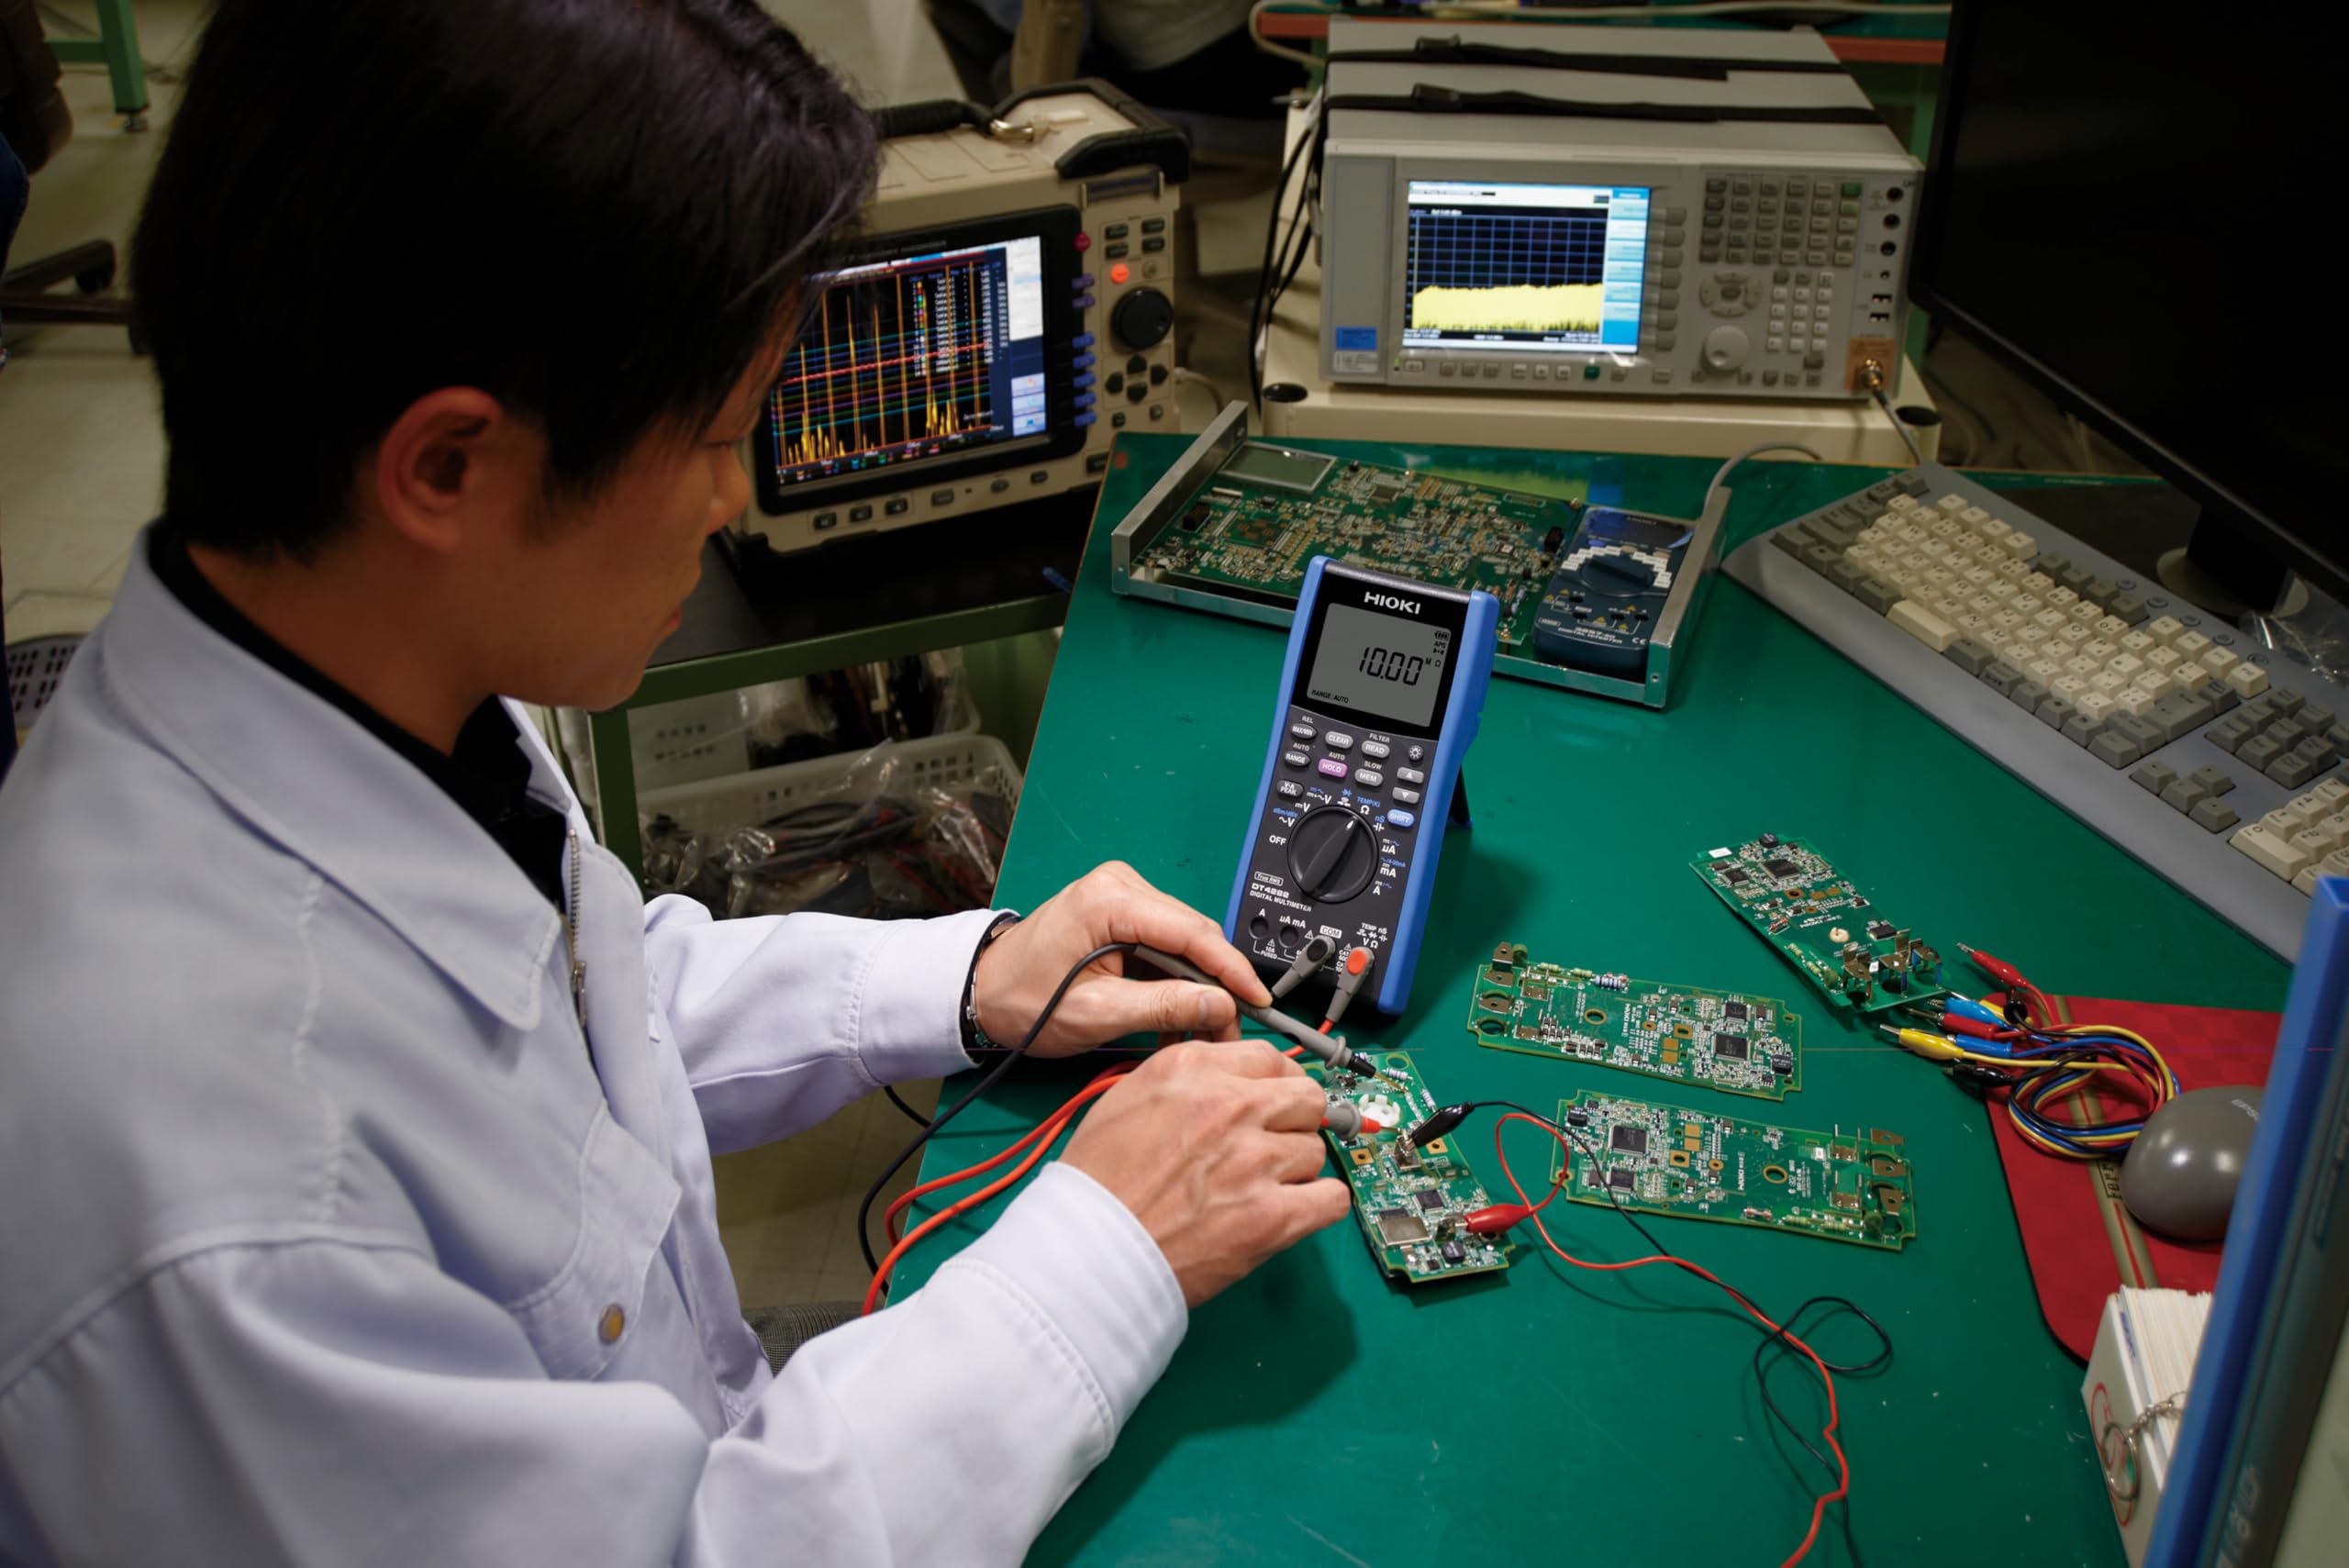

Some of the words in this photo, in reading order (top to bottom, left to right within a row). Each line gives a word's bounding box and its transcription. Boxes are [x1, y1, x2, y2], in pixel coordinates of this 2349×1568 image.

[1364, 592, 1420, 615] HIOKI
[1359, 647, 1423, 685] 10.00
[1312, 689, 1330, 699] RANGE
[1334, 695, 1349, 704] AUTO
[1302, 716, 1313, 724] REL
[1328, 735, 1349, 745] CLEAR
[1369, 733, 1390, 743] FILTER
[1293, 742, 1310, 751] AUTO
[1365, 744, 1385, 754] READ
[1286, 753, 1306, 764] RANGE
[1329, 751, 1345, 761] AUTO
[1322, 762, 1341, 773] HOLD
[1364, 761, 1382, 770] SLOW
[1360, 773, 1377, 782] MEM
[1280, 786, 1297, 796] PEAK
[1375, 816, 1385, 824] nS
[1390, 812, 1410, 824] SHIFT
[1269, 835, 1286, 845] OFF
[1380, 867, 1397, 877] mA
[1252, 883, 1289, 899] DT4282
[1373, 885, 1380, 895] A
[1250, 890, 1273, 901] DIGITAL
[1274, 896, 1312, 913] MULTIMETER
[1258, 907, 1265, 917] A
[1292, 919, 1306, 929] mA
[1362, 922, 1377, 931] TEMP
[1321, 927, 1341, 937] COM
[1363, 937, 1370, 946] V
[1260, 950, 1277, 960] FUSED
